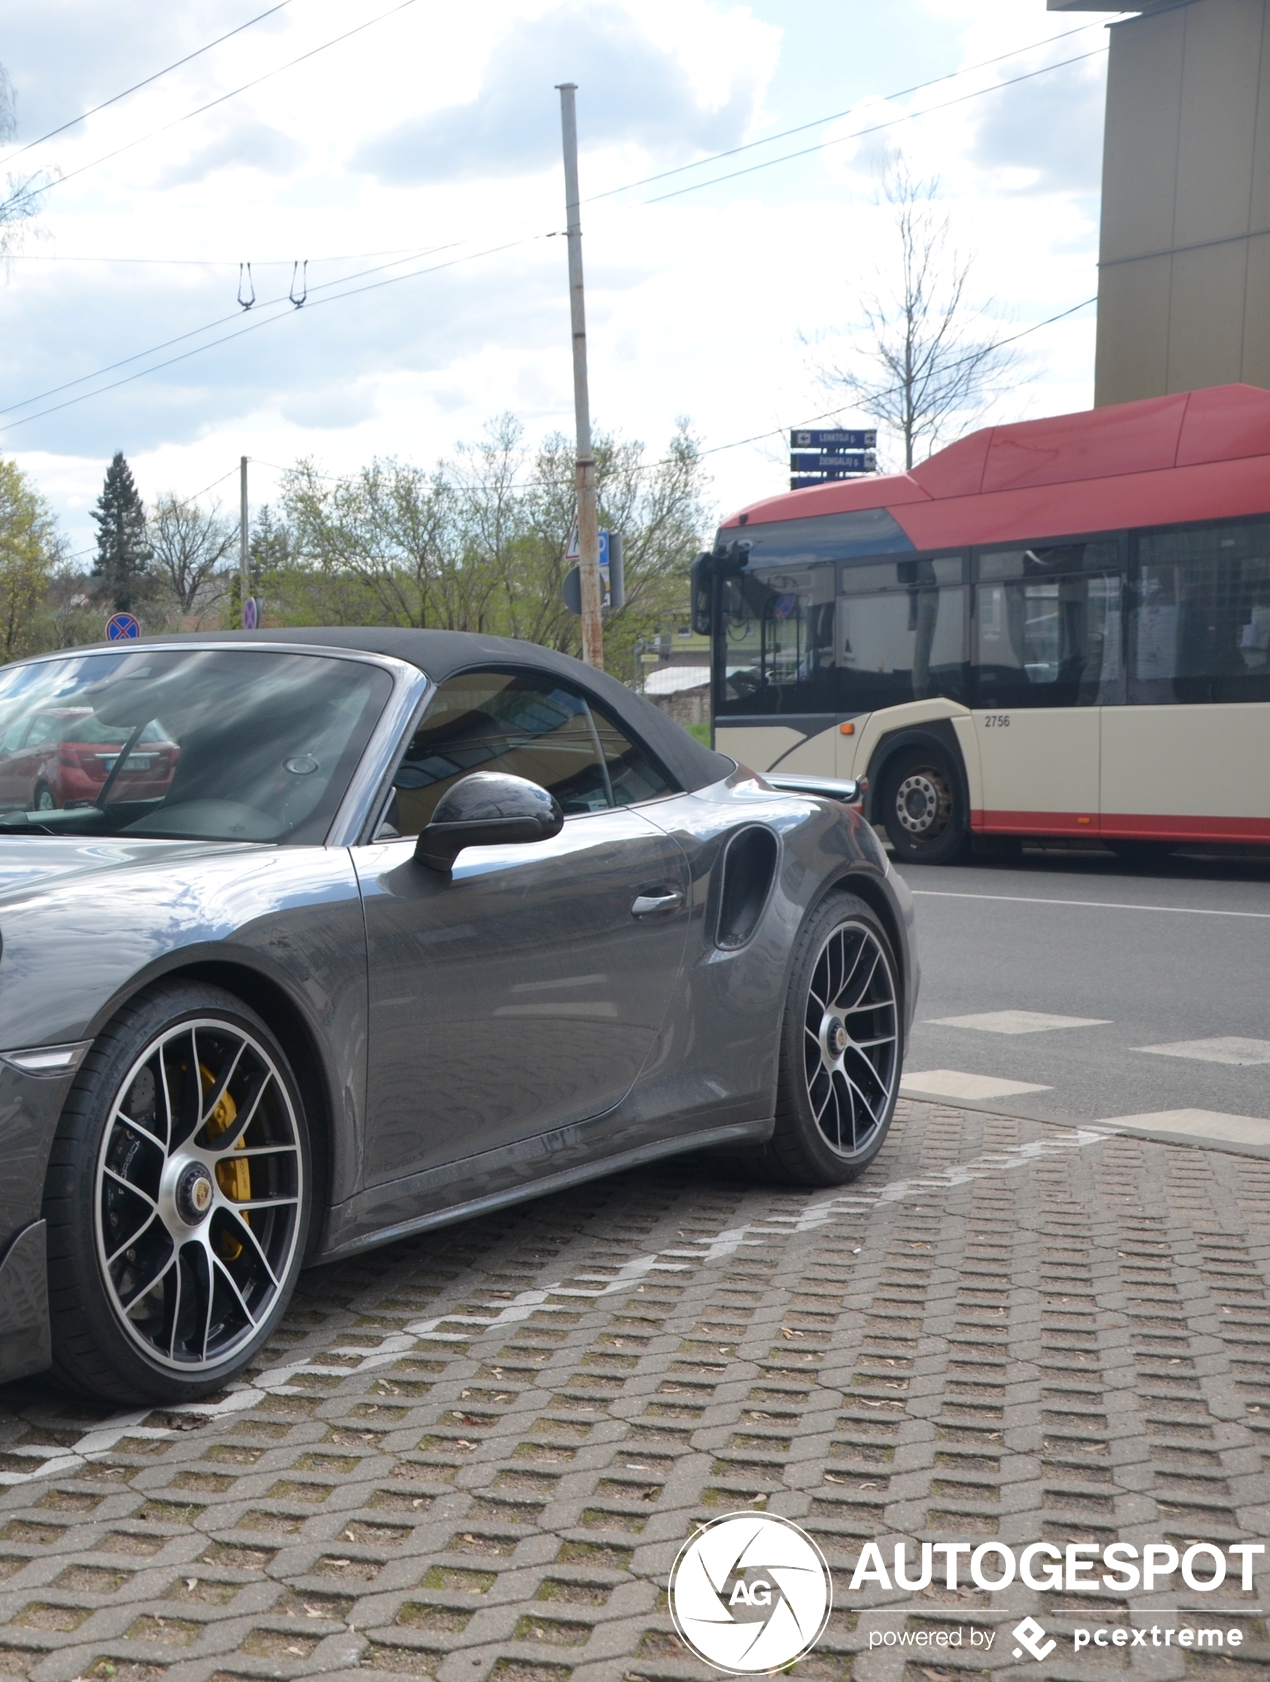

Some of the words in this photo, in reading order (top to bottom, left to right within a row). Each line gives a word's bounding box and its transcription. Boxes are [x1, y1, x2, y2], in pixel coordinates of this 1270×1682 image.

[819, 433, 849, 443] LENKTOJI
[985, 715, 1010, 727] 2756
[118, 1140, 141, 1195] PORSC
